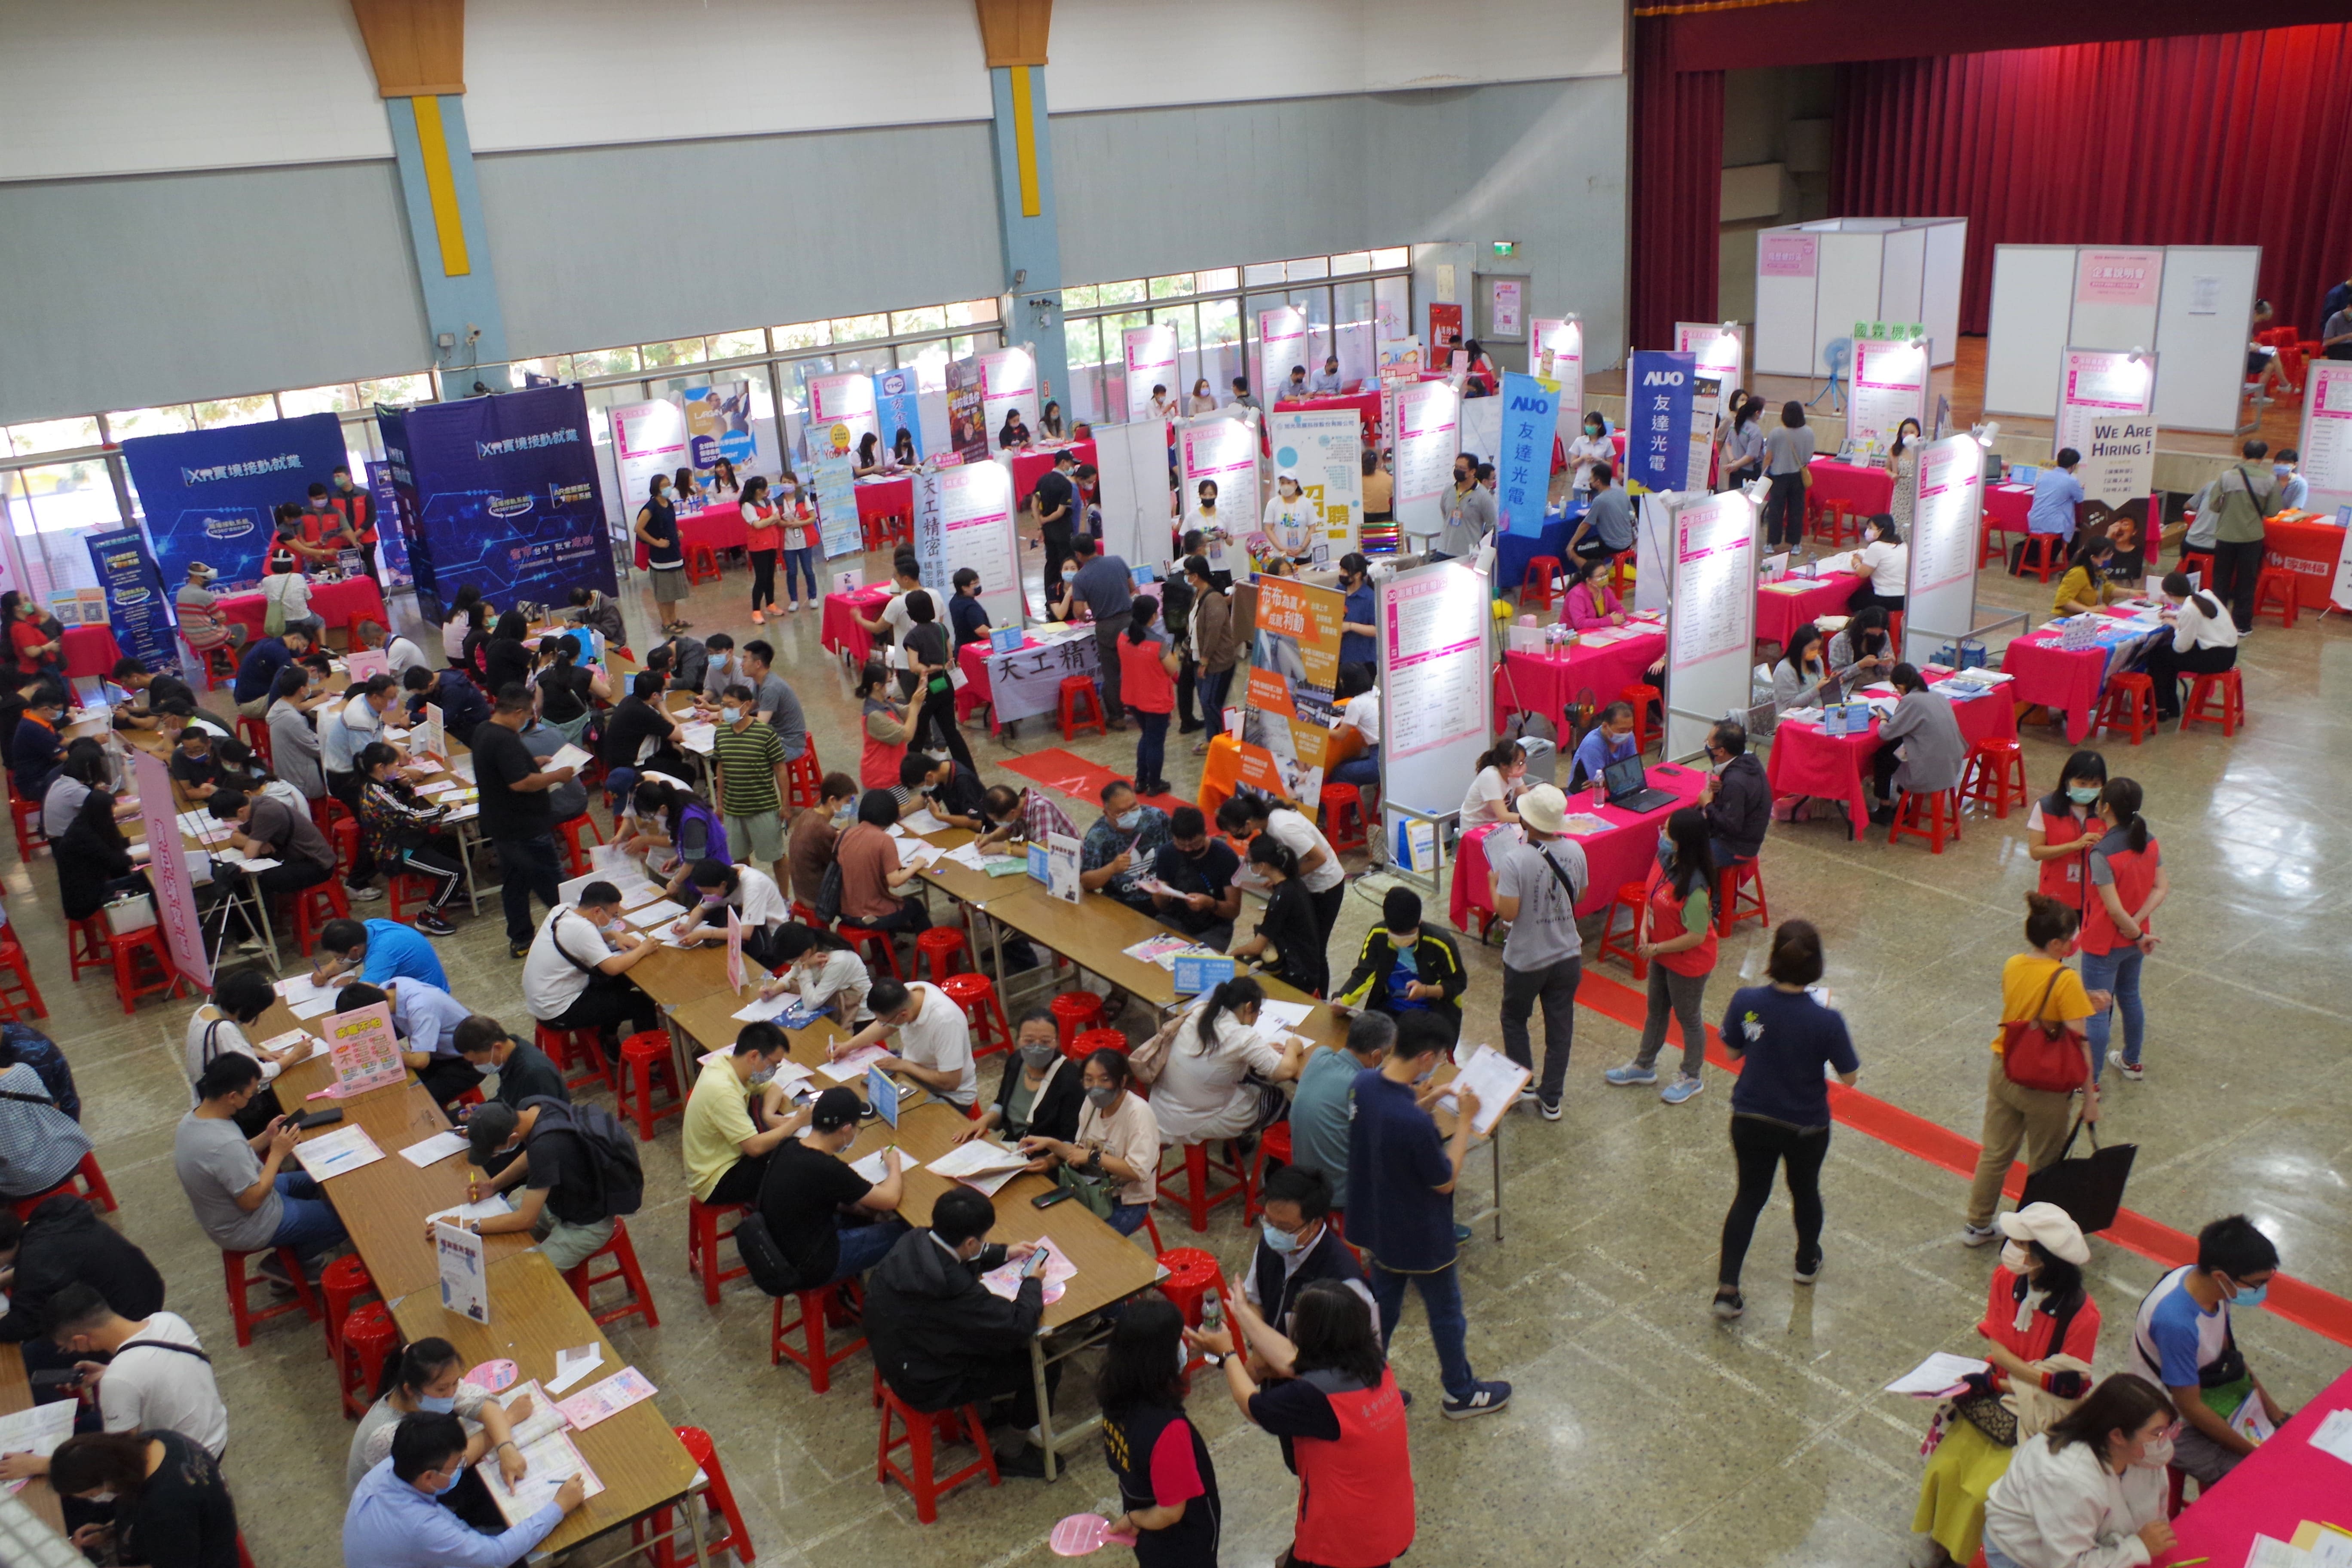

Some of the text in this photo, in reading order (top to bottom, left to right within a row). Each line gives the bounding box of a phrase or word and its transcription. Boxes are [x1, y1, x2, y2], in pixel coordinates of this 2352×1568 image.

[1510, 395, 1549, 415] AUO
[1644, 371, 1684, 386] AUO
[1649, 394, 1671, 472] 友達光電
[1507, 422, 1534, 505] 友達光電
[922, 478, 940, 557] 天工精密
[999, 642, 1102, 683] 天工精
